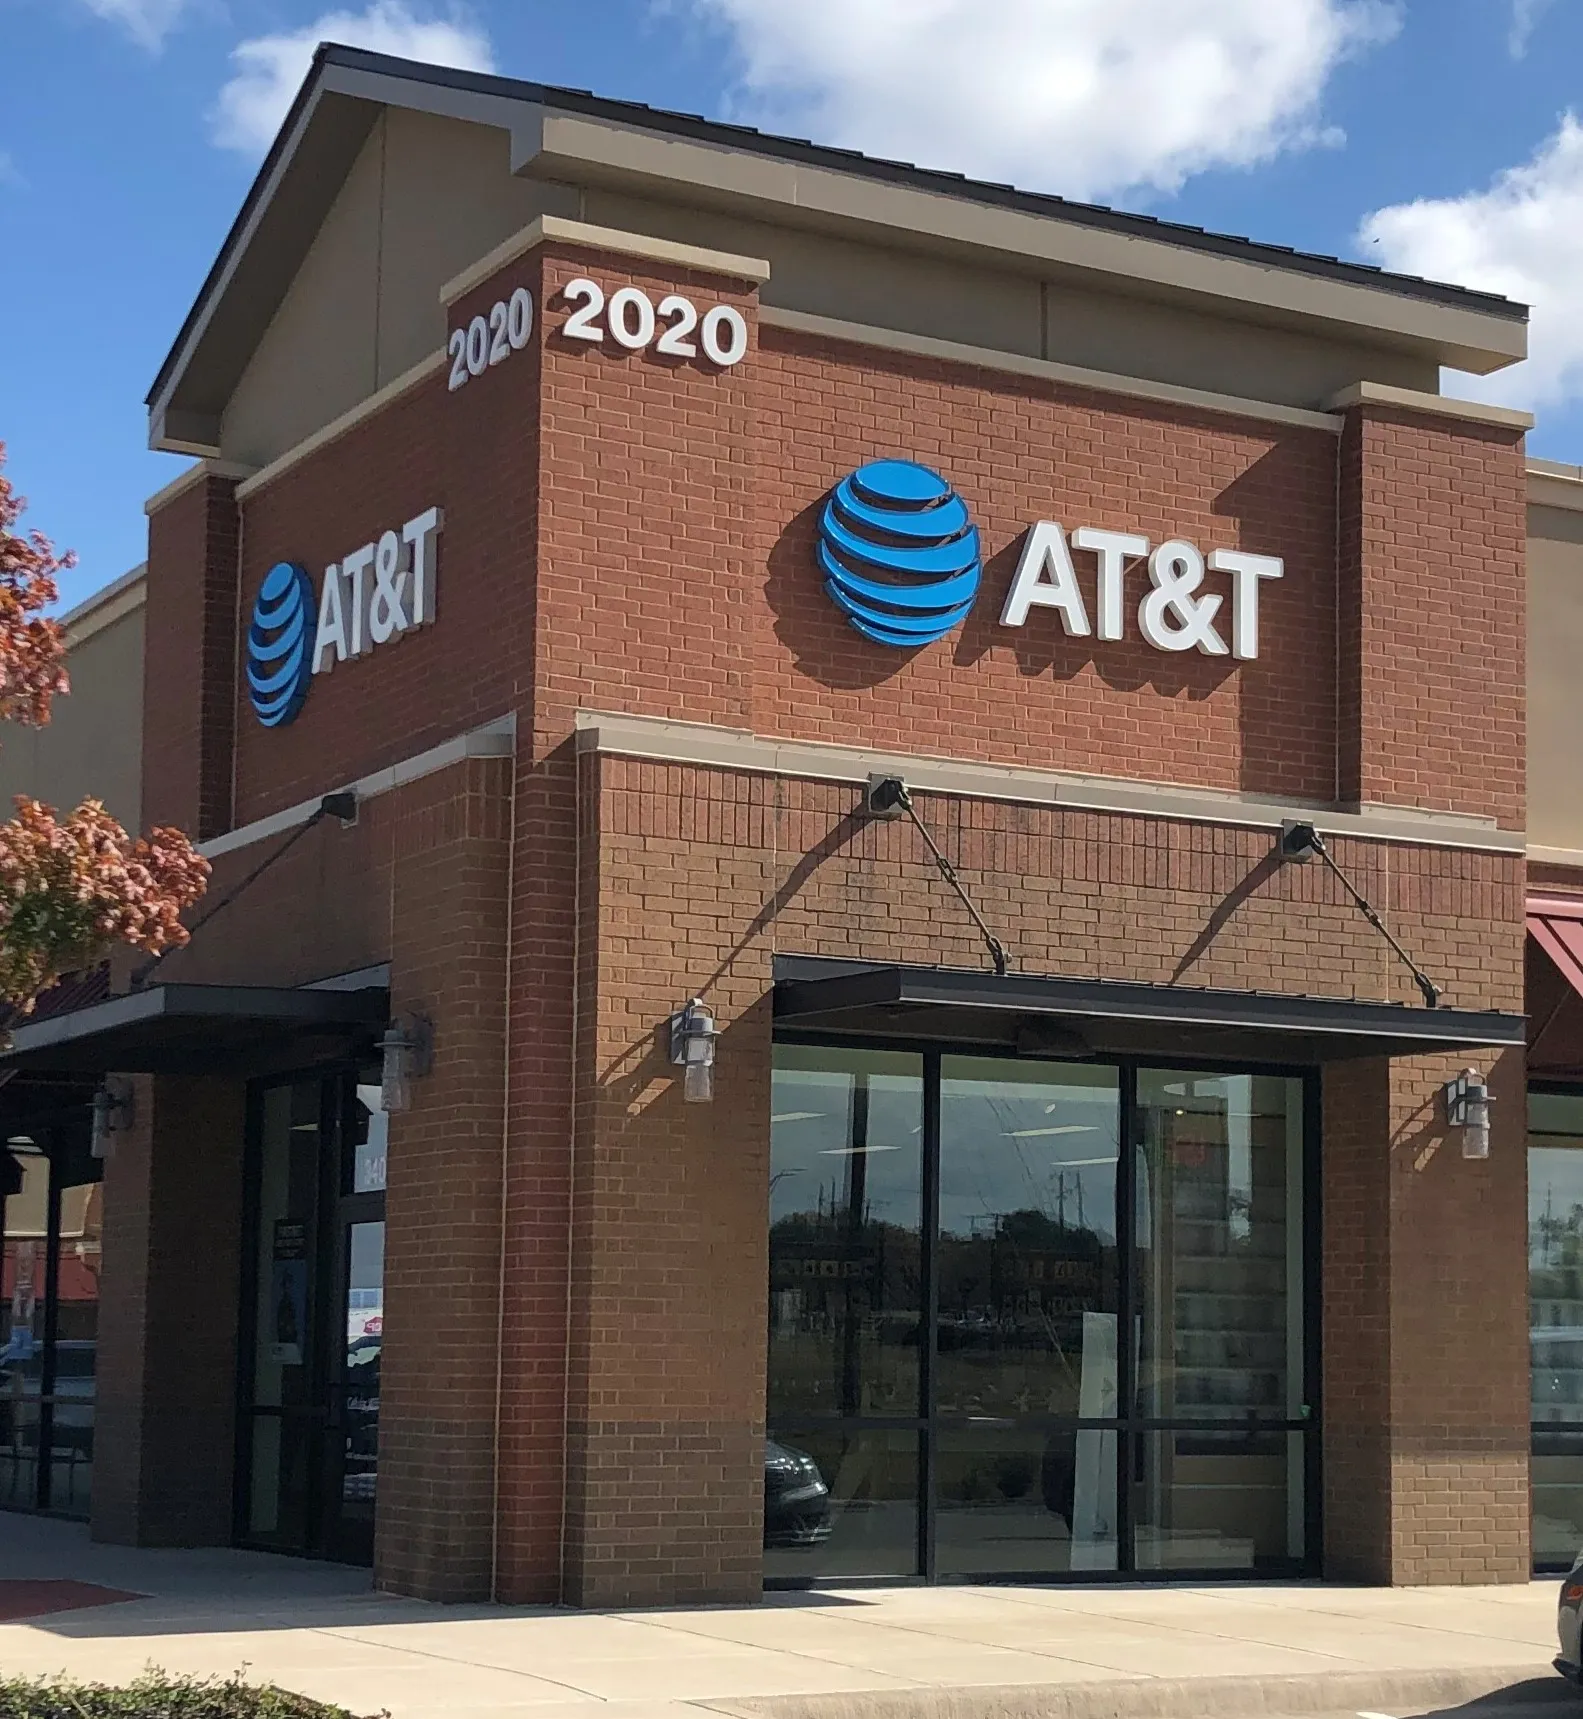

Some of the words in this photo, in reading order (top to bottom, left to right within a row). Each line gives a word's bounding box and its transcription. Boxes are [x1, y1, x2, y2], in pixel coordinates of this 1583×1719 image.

[448, 287, 533, 392] 2020
[562, 278, 747, 366] 2020
[311, 506, 444, 675] AT&T
[999, 520, 1284, 660] AT&T
